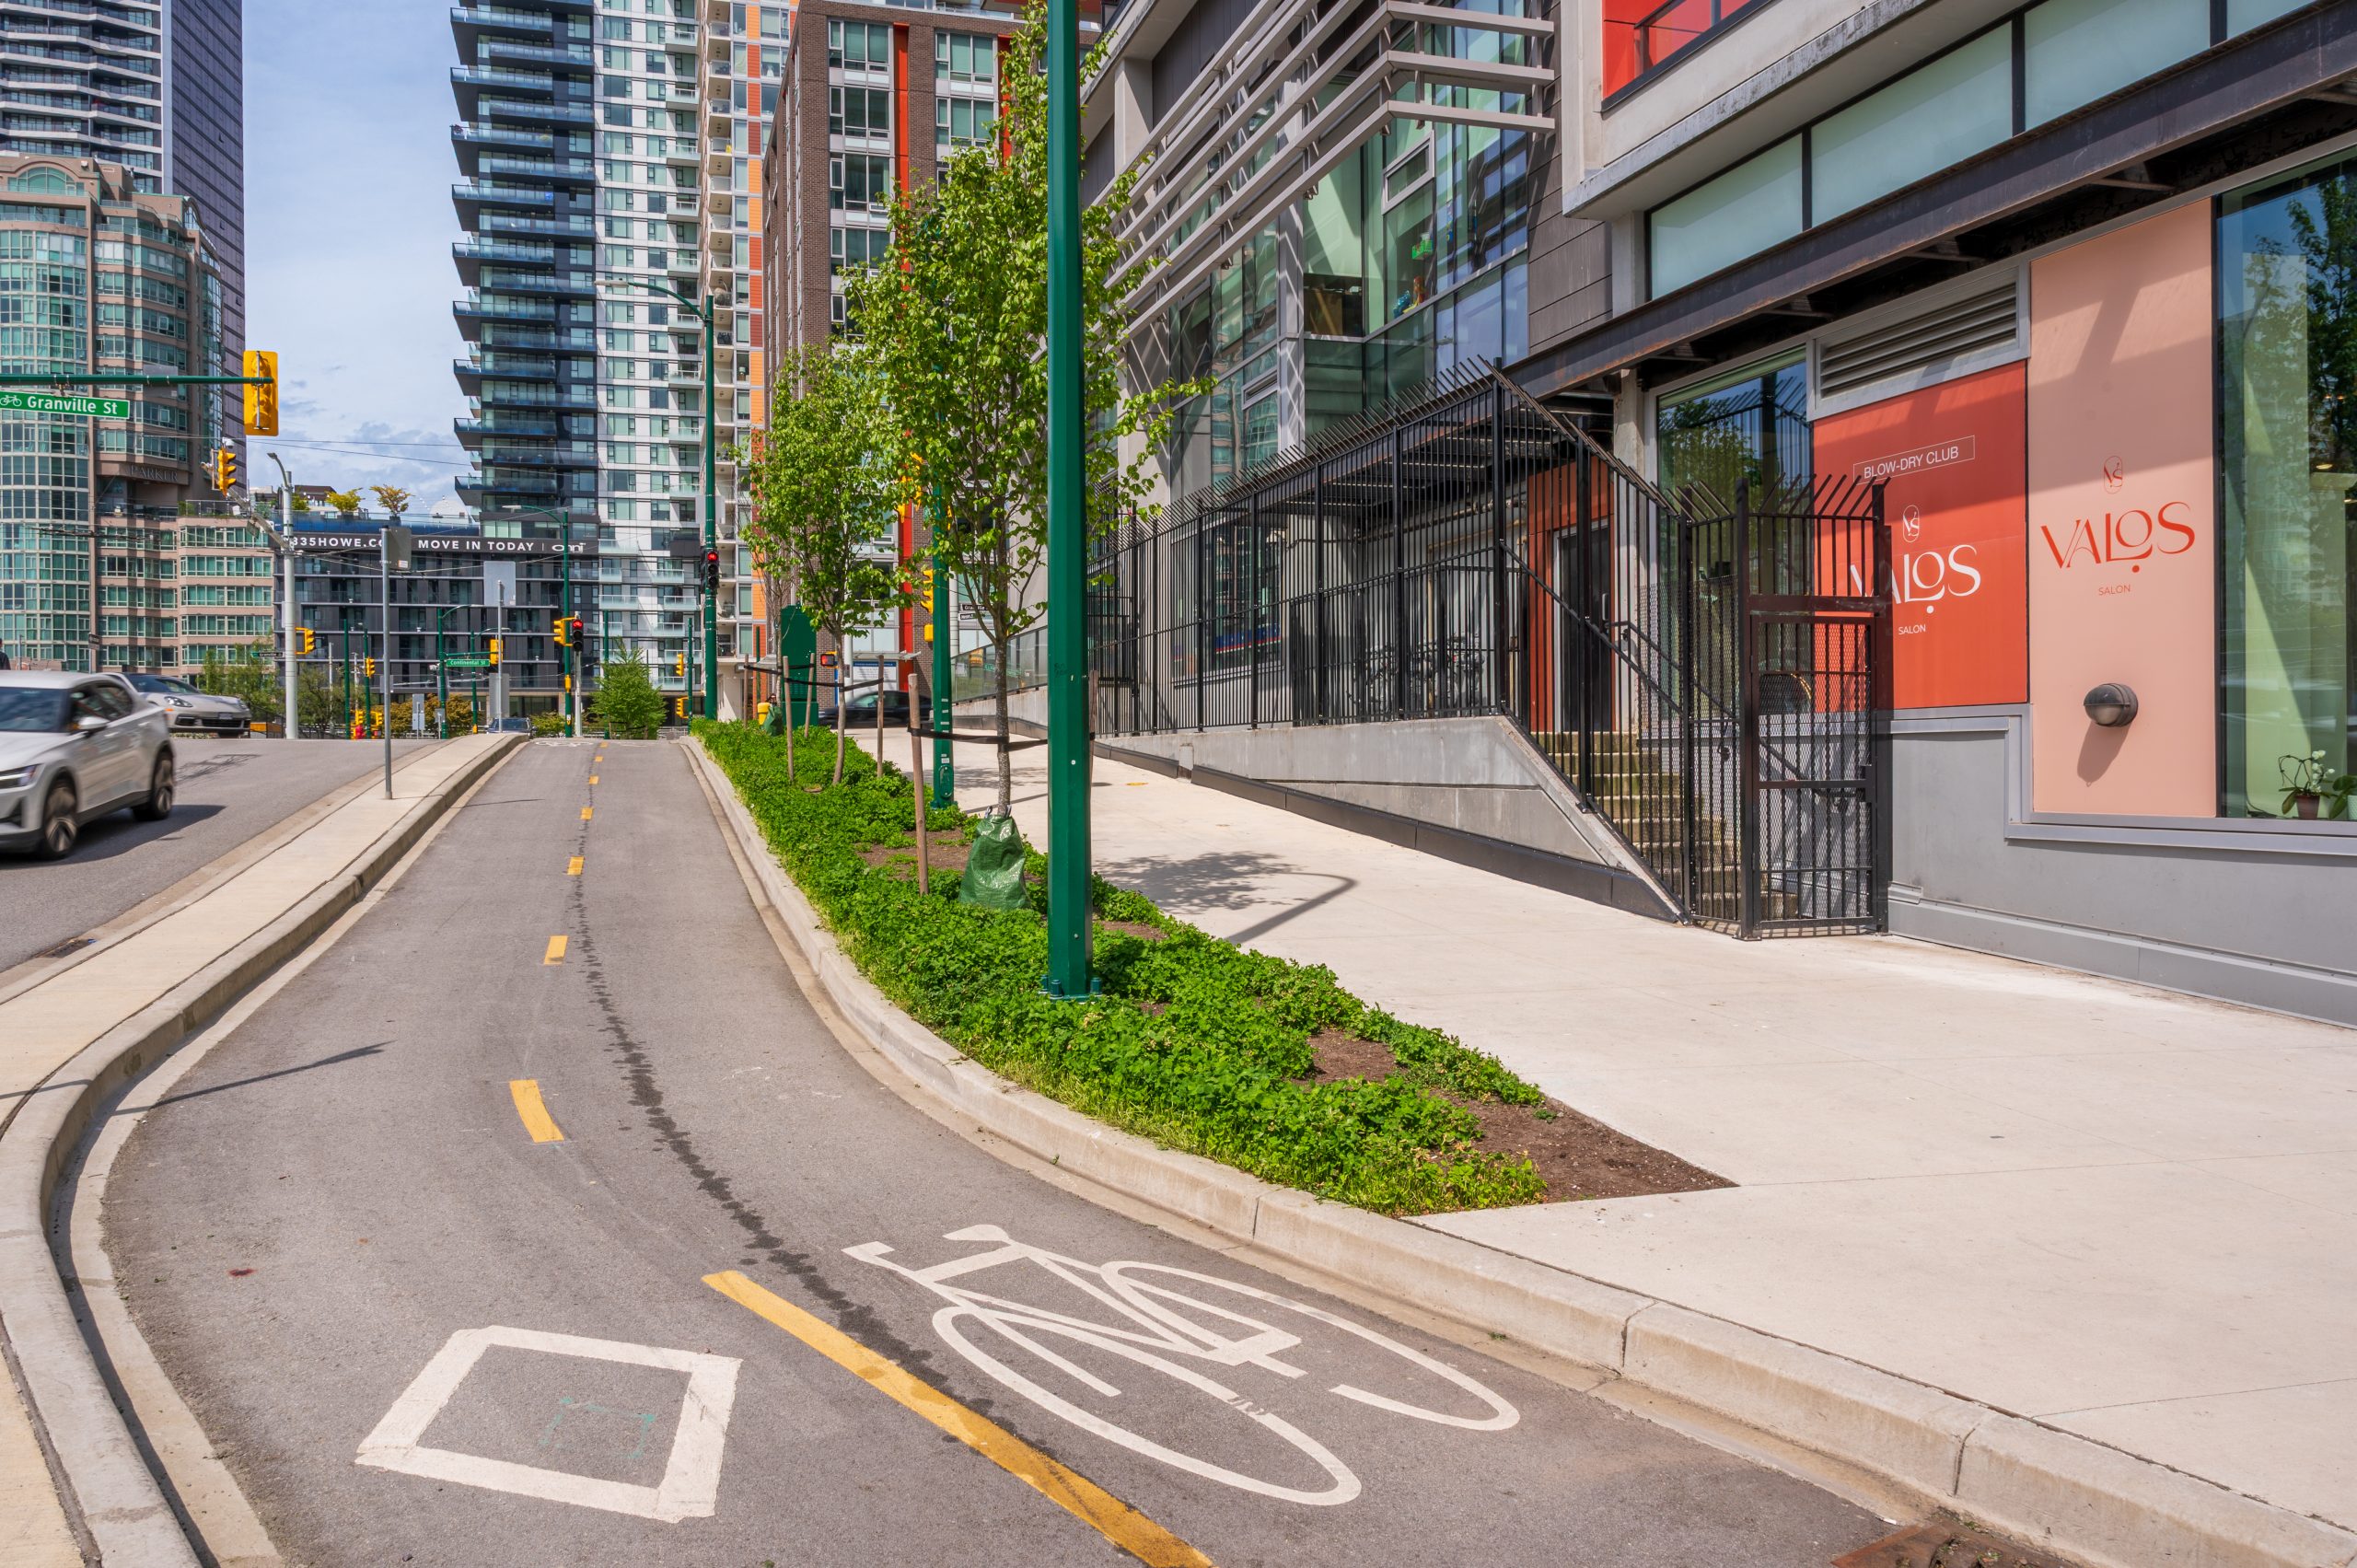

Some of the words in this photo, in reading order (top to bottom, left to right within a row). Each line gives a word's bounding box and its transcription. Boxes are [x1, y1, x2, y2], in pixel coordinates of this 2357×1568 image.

[27, 395, 97, 412] Granville
[103, 401, 118, 415] St
[1864, 455, 1923, 480] BLOW-DRY
[1926, 446, 1959, 465] CLUB
[131, 464, 178, 482] PARKER
[418, 540, 459, 551] MOVE
[466, 540, 481, 551] IN
[487, 541, 534, 552] TODAY
[2040, 501, 2196, 574] VALOS
[2098, 585, 2131, 596] SALON
[1898, 623, 1926, 635] SALON
